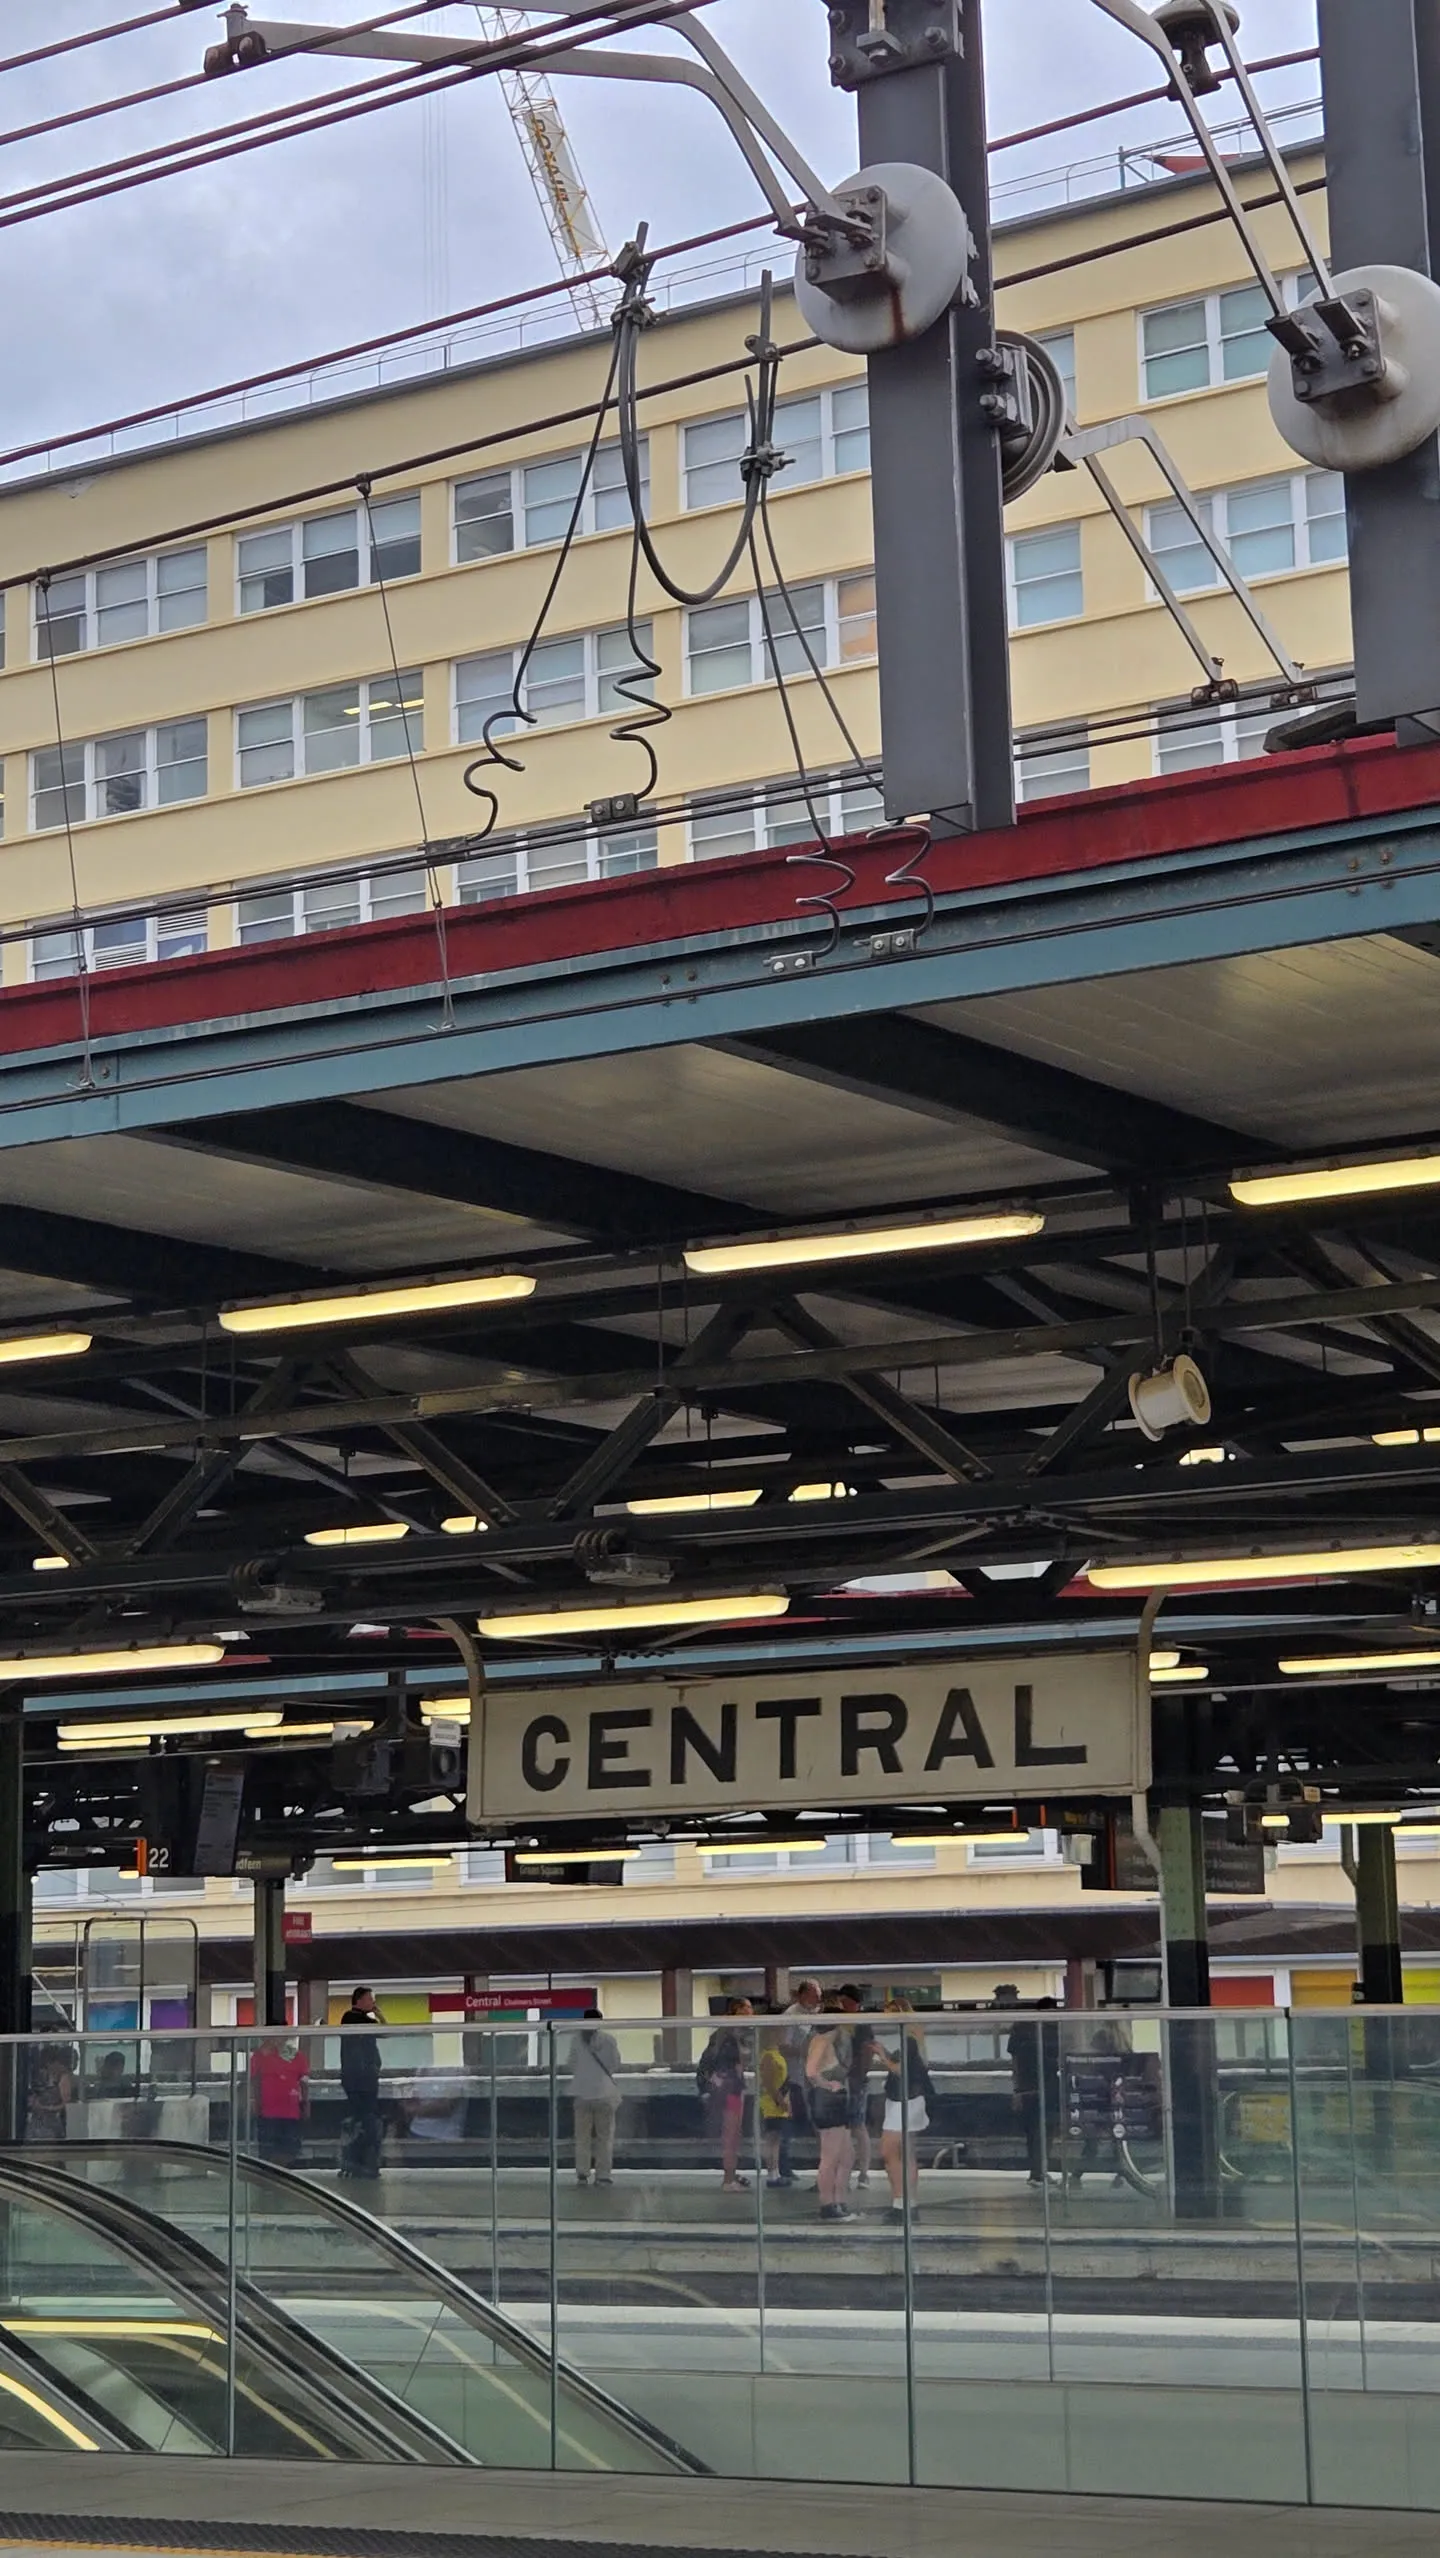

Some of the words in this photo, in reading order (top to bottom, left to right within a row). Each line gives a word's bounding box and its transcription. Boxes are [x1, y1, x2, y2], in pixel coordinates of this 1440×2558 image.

[521, 1684, 1087, 1792] CENTRAL
[149, 1848, 169, 1868] 22
[465, 1995, 501, 2008] Central
